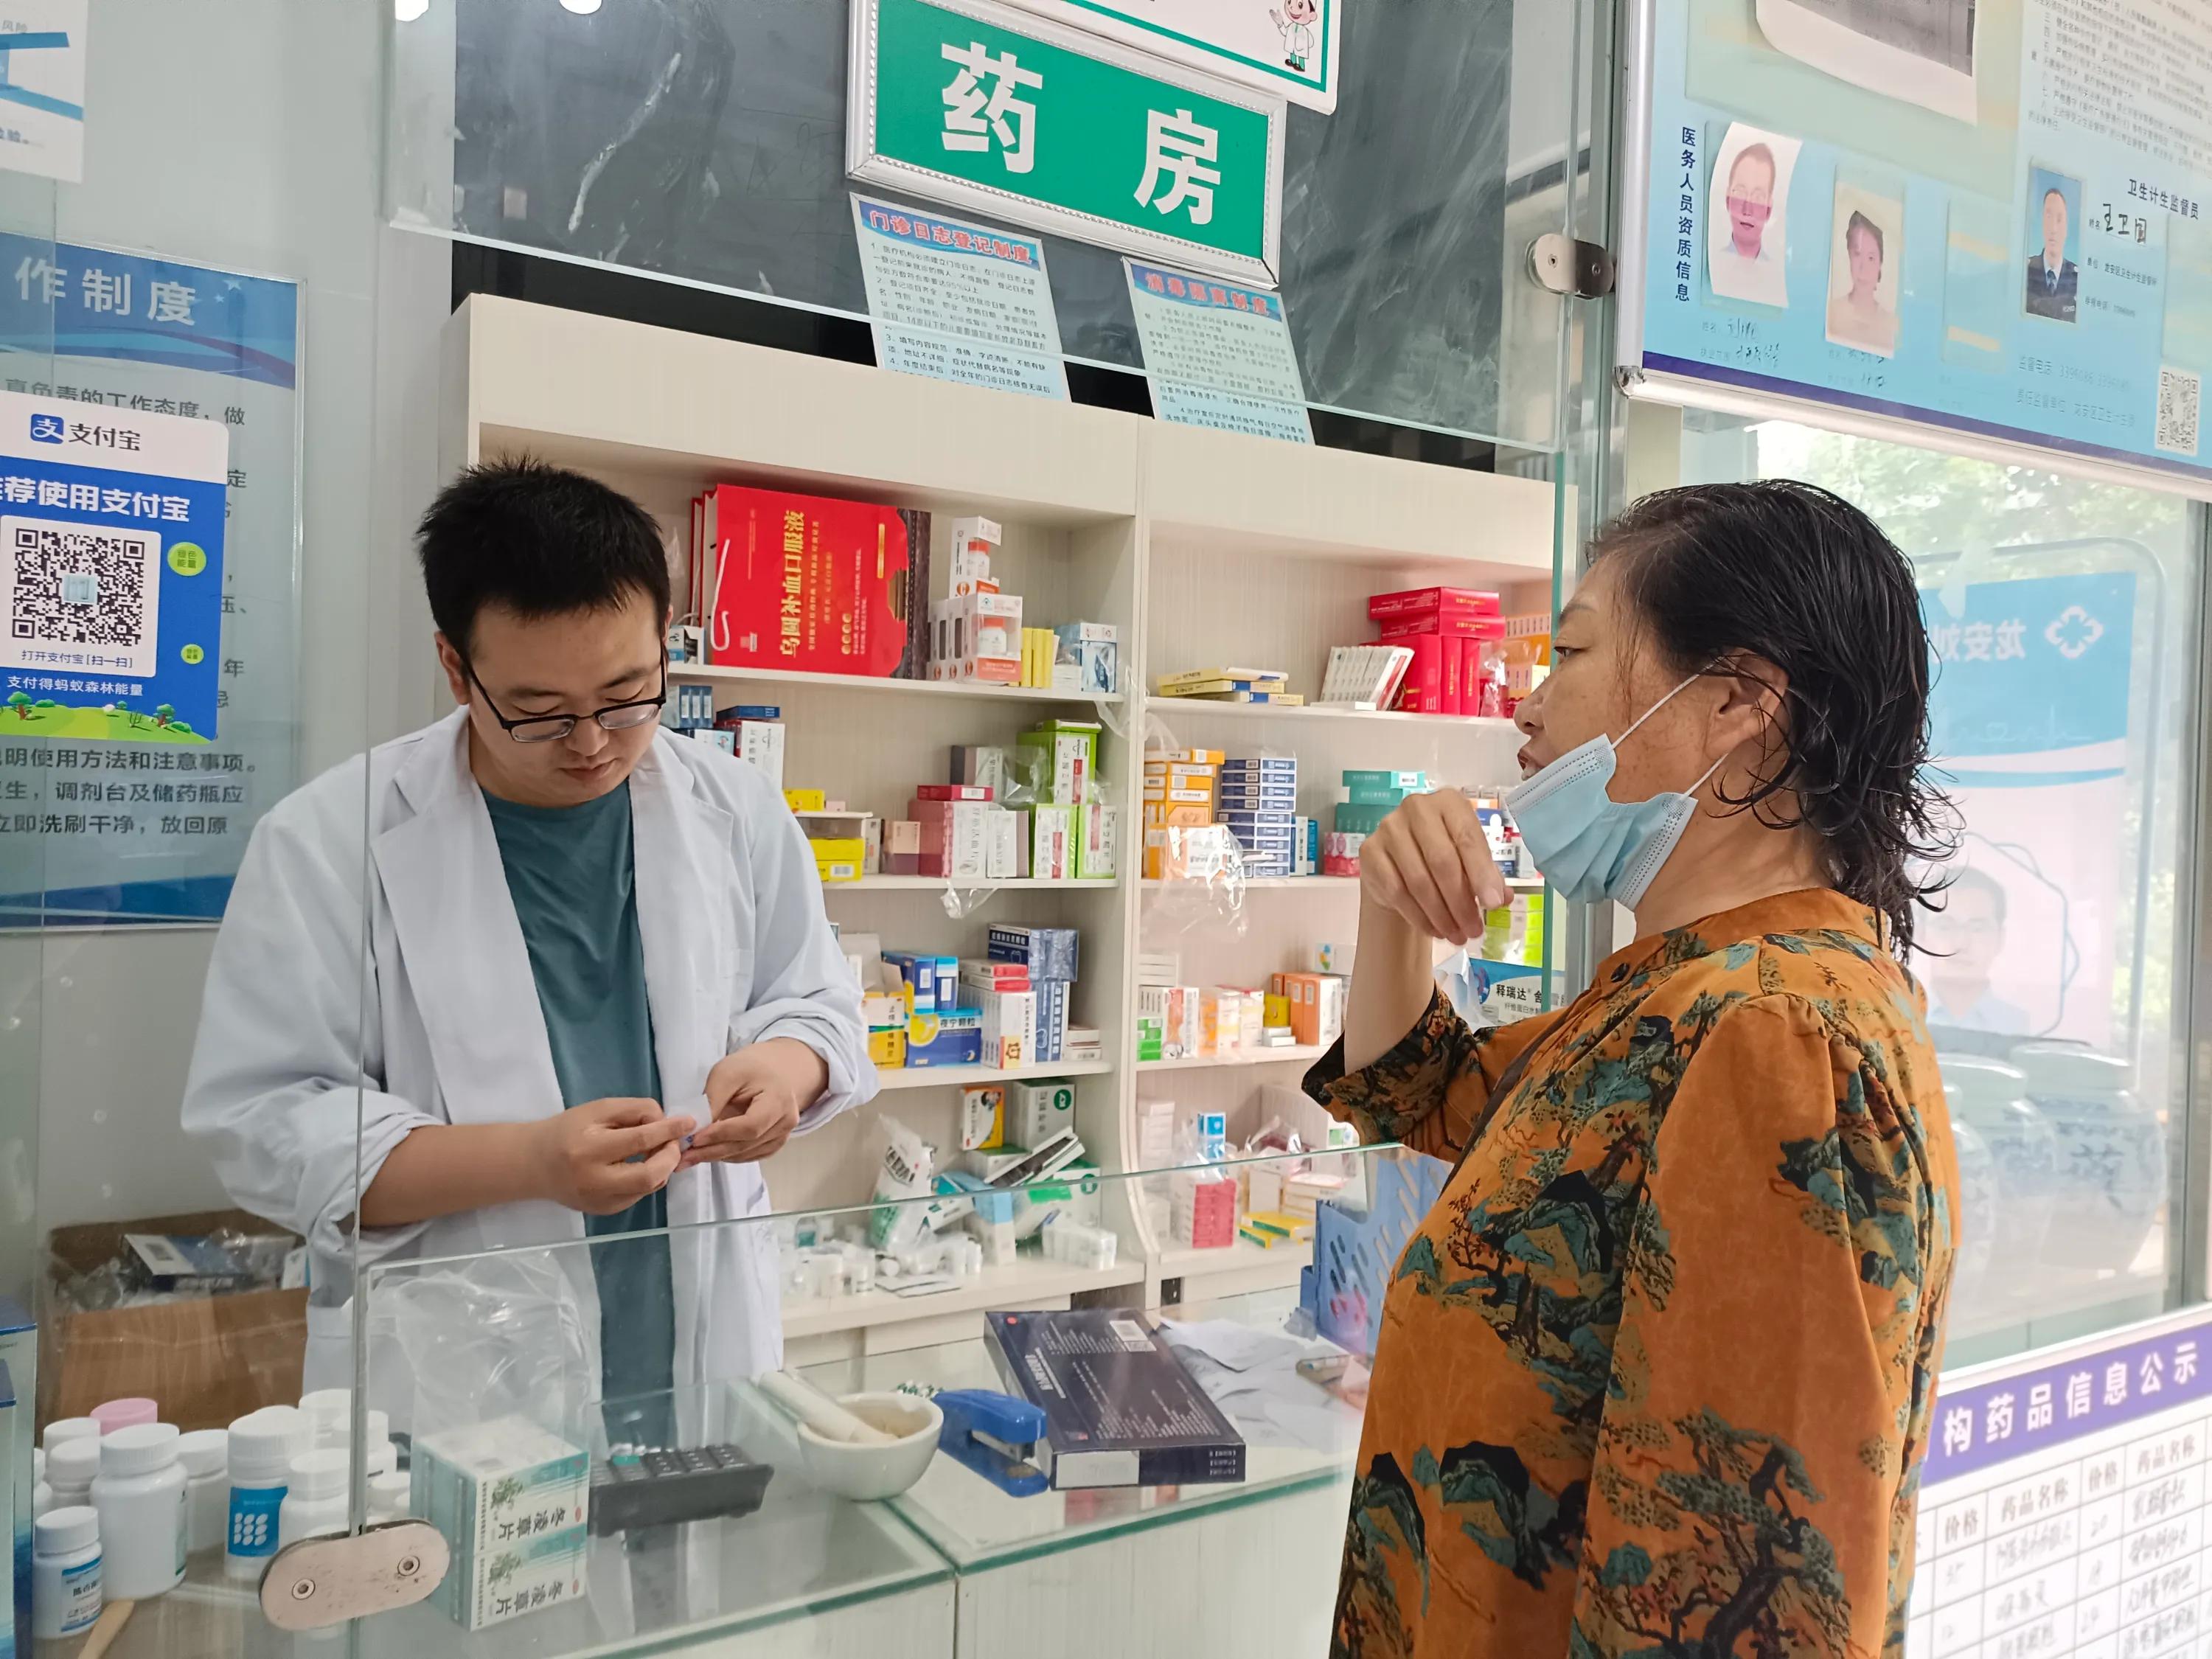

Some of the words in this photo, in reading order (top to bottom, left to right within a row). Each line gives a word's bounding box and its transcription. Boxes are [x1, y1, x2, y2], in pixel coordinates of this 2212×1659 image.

[941, 42, 1222, 225] 药房
[1675, 126, 1697, 302] 医务人员资质信息
[2127, 178, 2199, 220] 卫生计生监督员
[869, 210, 1032, 264] 门诊日志登记制度
[15, 256, 196, 326] 作制度
[69, 423, 141, 451] 支付宝
[0, 476, 190, 523] 荐使用支付宝
[7, 675, 144, 697] 支付得蚂蚁森林能量
[0, 747, 257, 773] 明使用方法和注意事项。
[0, 780, 244, 804] 生，调剂台及储药瓶应
[1924, 1341, 2198, 1464] 构药品信息公示
